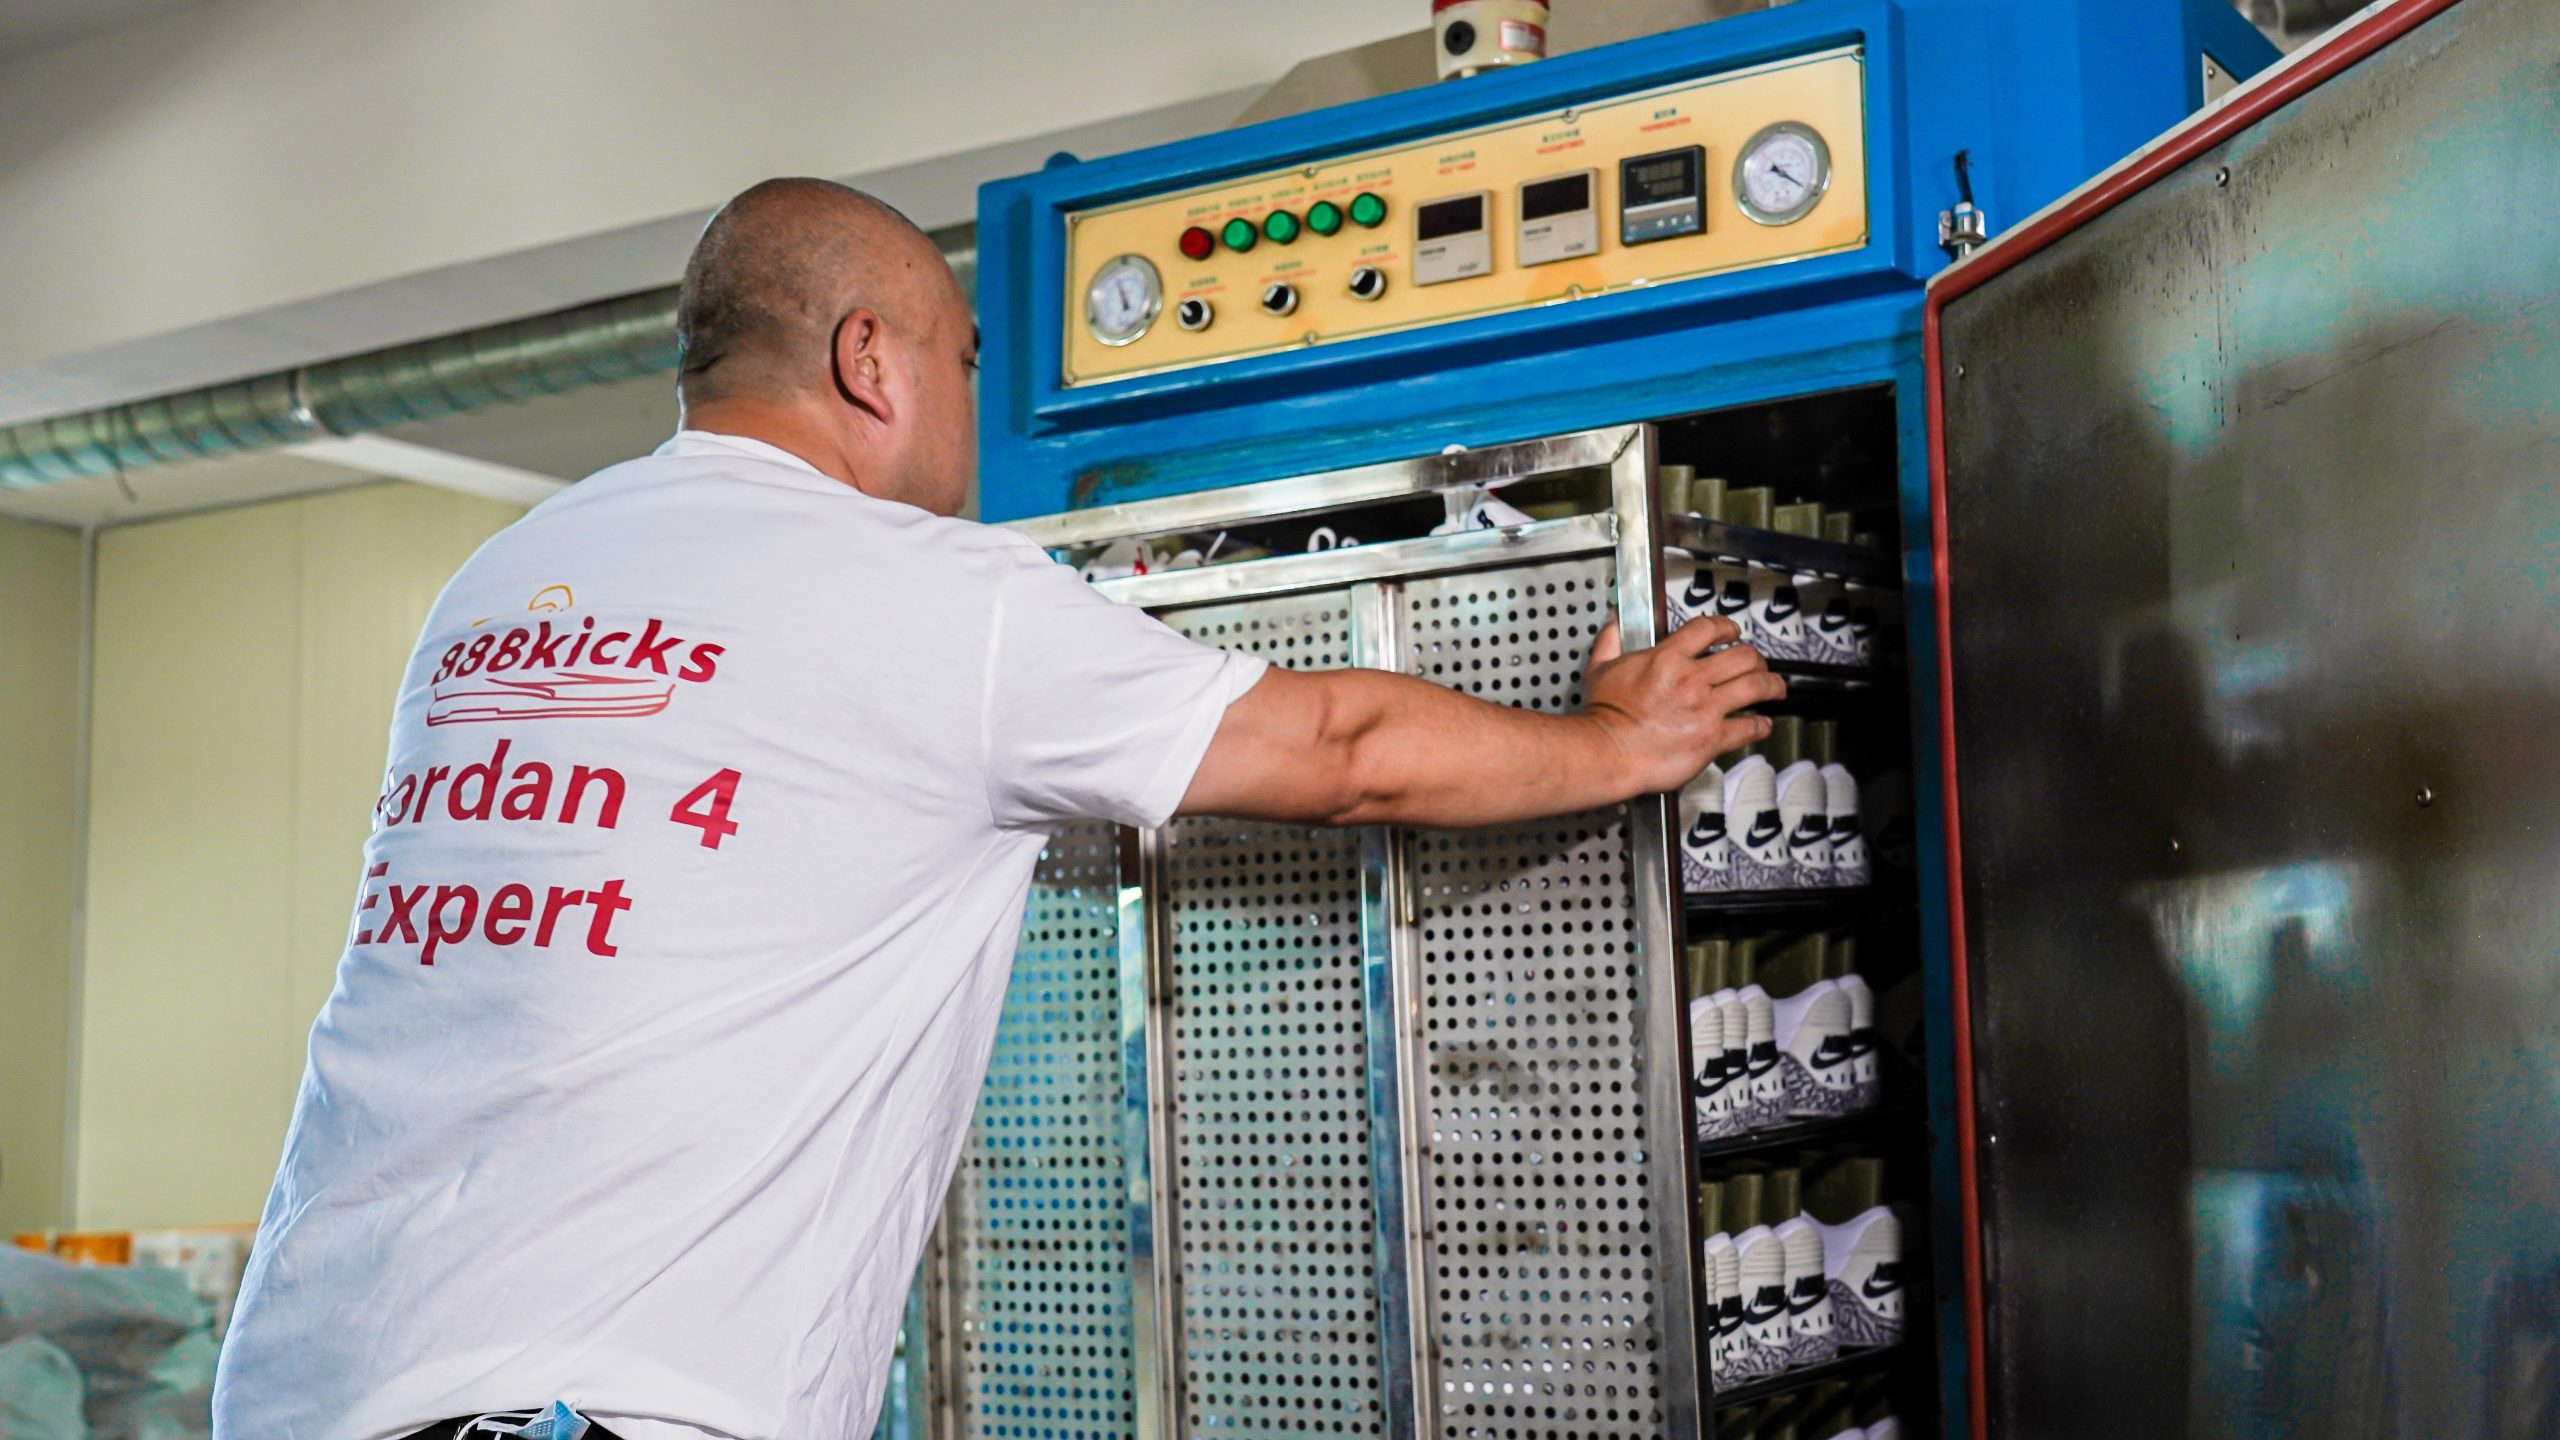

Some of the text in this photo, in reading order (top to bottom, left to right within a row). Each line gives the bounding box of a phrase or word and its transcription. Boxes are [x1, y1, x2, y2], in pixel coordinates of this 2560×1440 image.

[375, 738, 743, 850] ordan 4
[352, 861, 632, 966] Expert
